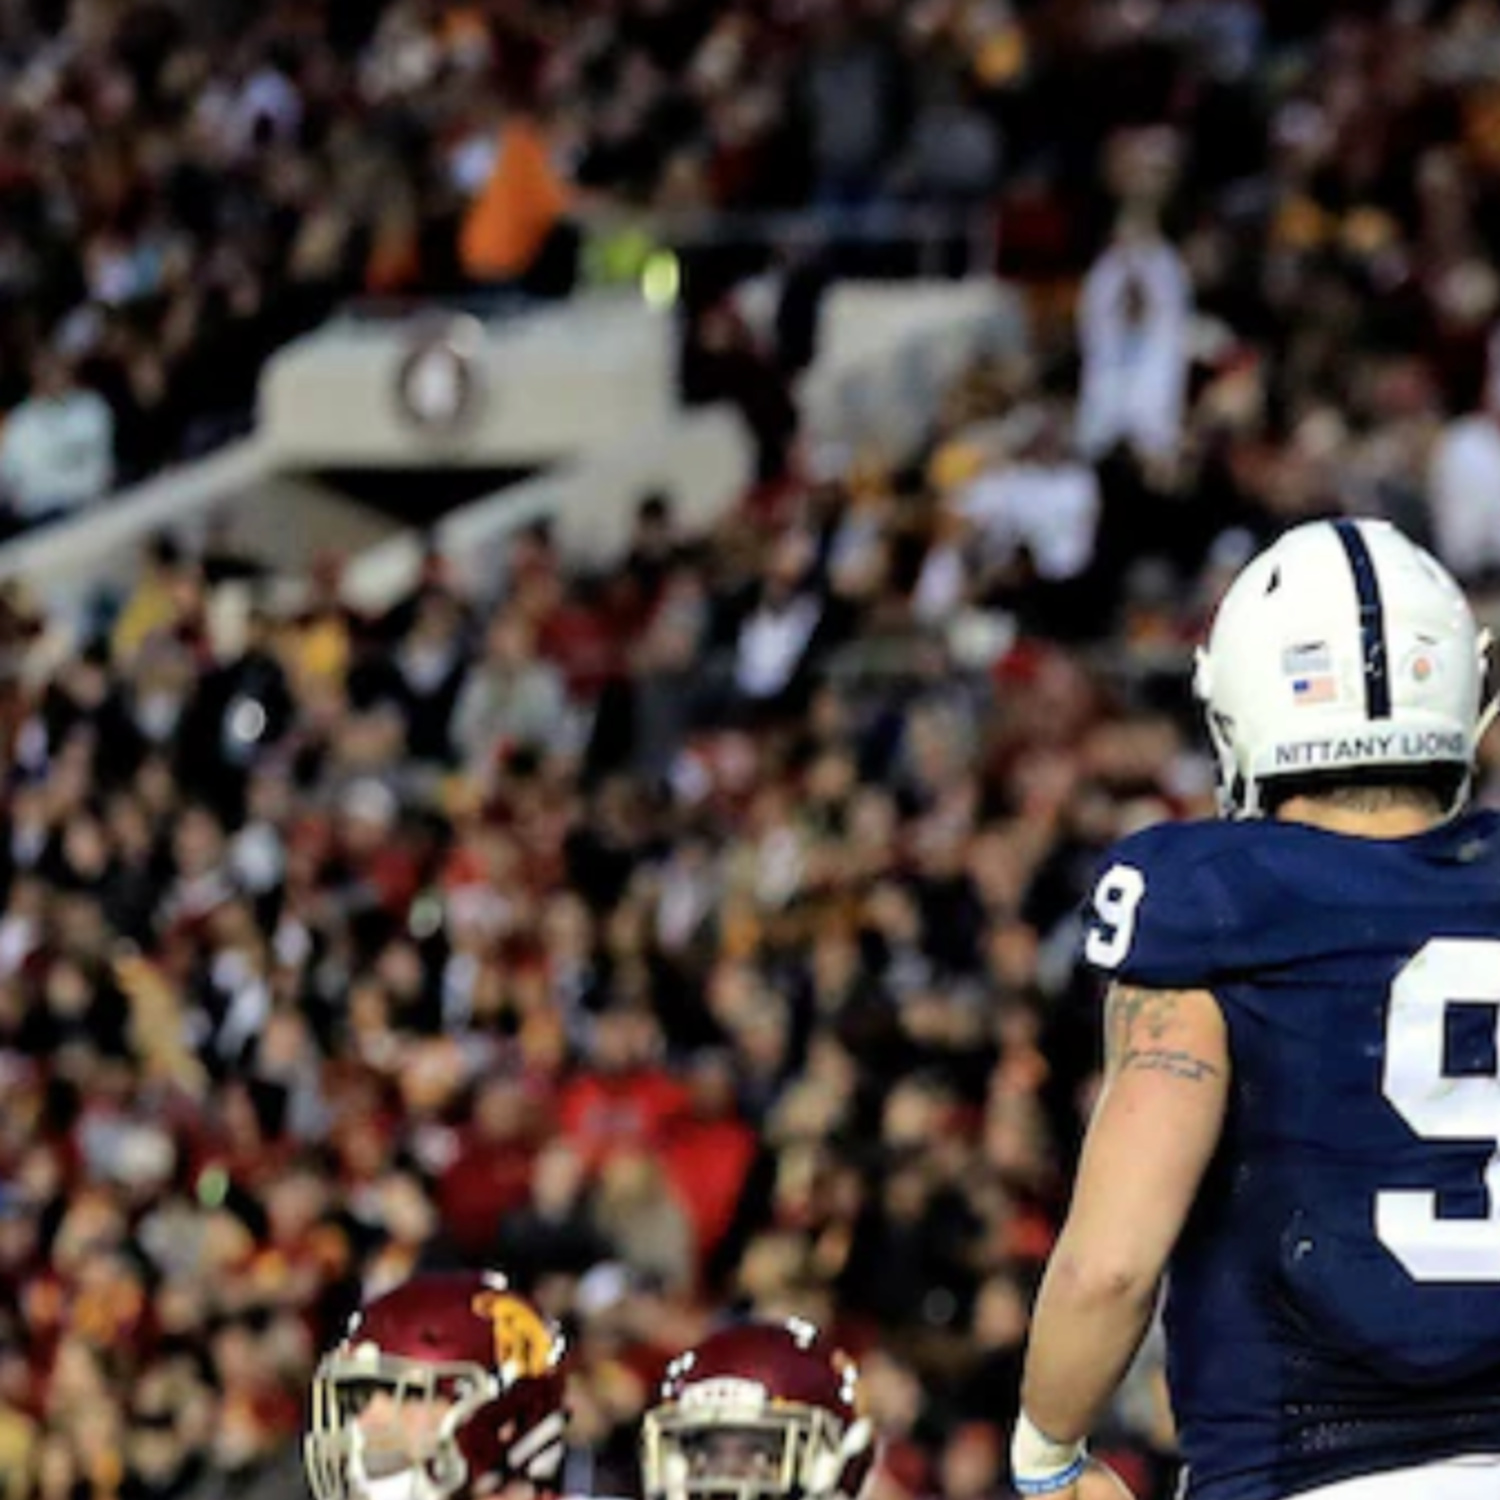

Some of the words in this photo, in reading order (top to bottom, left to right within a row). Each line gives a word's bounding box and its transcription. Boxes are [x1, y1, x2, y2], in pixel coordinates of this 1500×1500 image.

[1275, 733, 1394, 766] NITTANY
[1402, 731, 1465, 756] LIONS
[1085, 864, 1146, 968] 9
